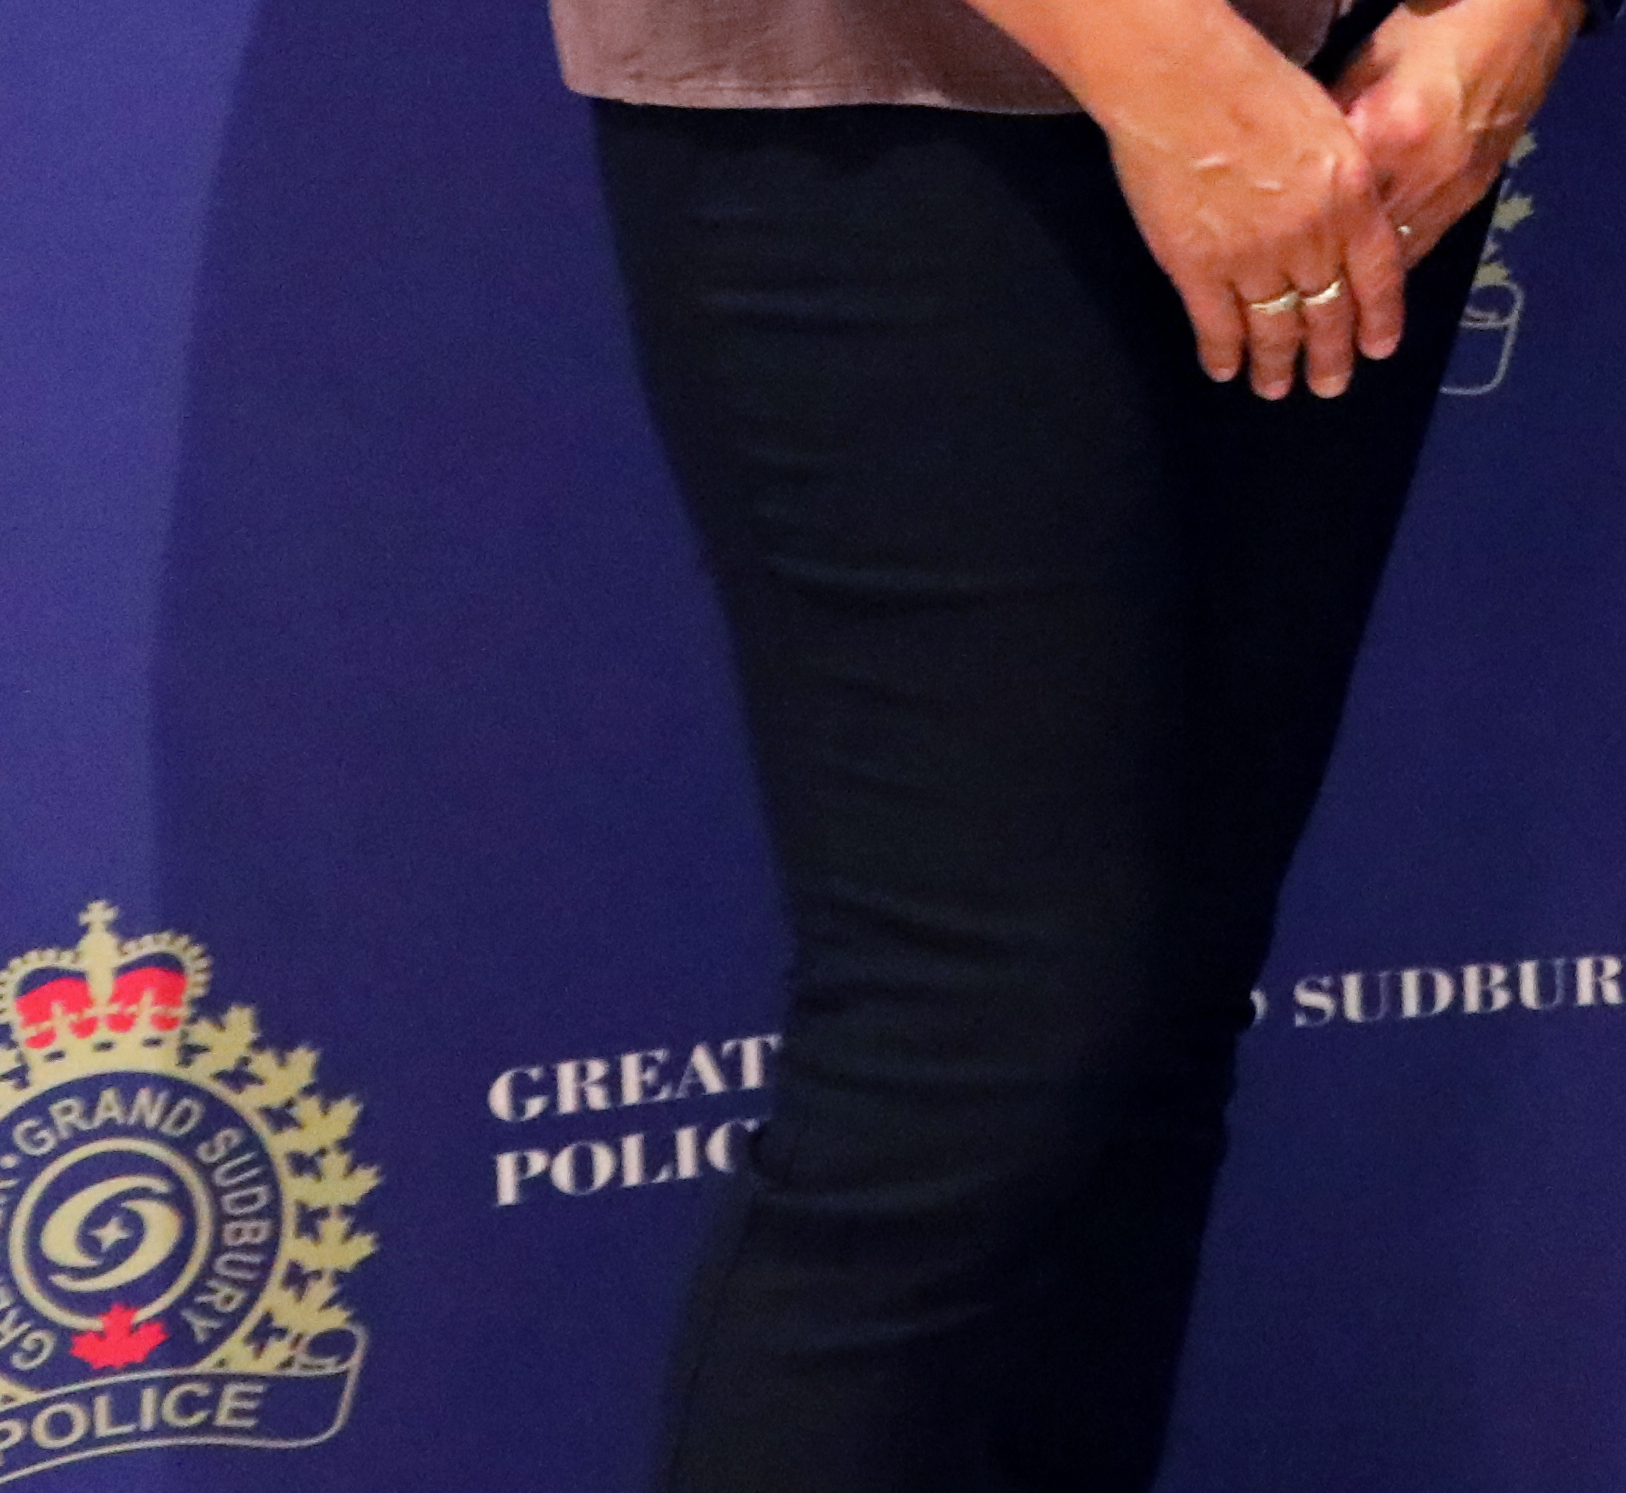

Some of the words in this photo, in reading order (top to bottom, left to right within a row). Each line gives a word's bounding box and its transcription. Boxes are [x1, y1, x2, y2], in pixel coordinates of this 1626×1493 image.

[487, 1033, 781, 1123] GREAT
[489, 1118, 768, 1208] POLIC
[12, 1086, 204, 1157] GRAND
[180, 1127, 273, 1345] SUDBURY
